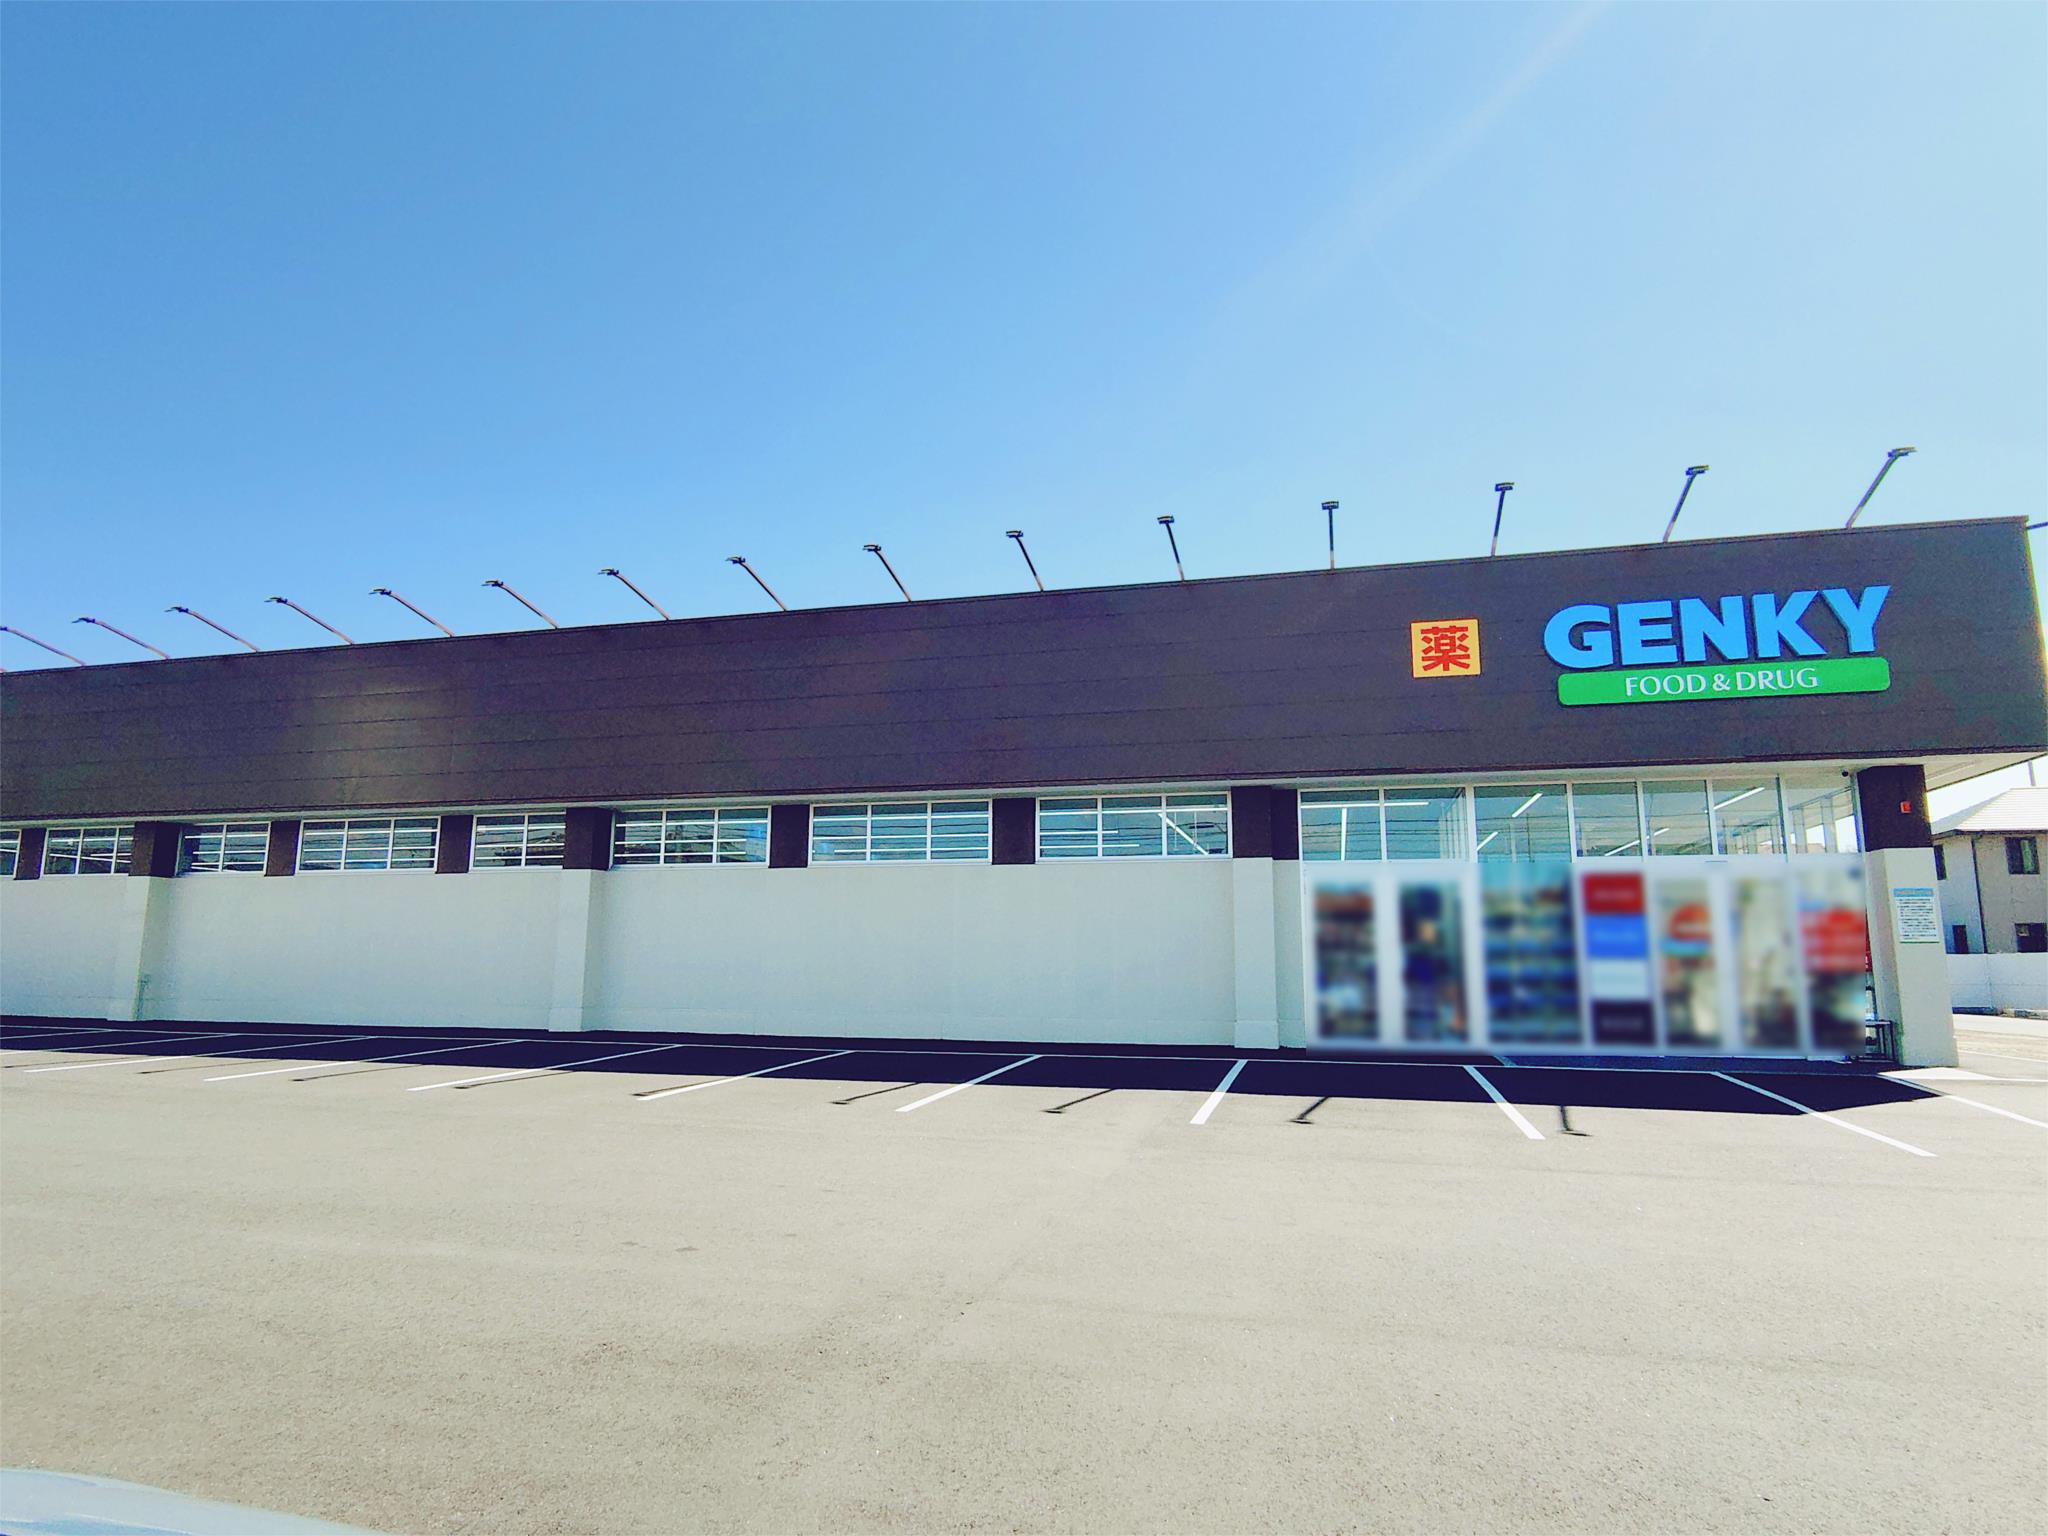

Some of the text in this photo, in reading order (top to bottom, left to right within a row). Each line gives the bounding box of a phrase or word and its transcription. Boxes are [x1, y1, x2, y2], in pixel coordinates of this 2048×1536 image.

[1420, 624, 1471, 671] 薬
[1543, 585, 1891, 669] GENKY
[1625, 667, 1818, 697] FOOD & DRUG
